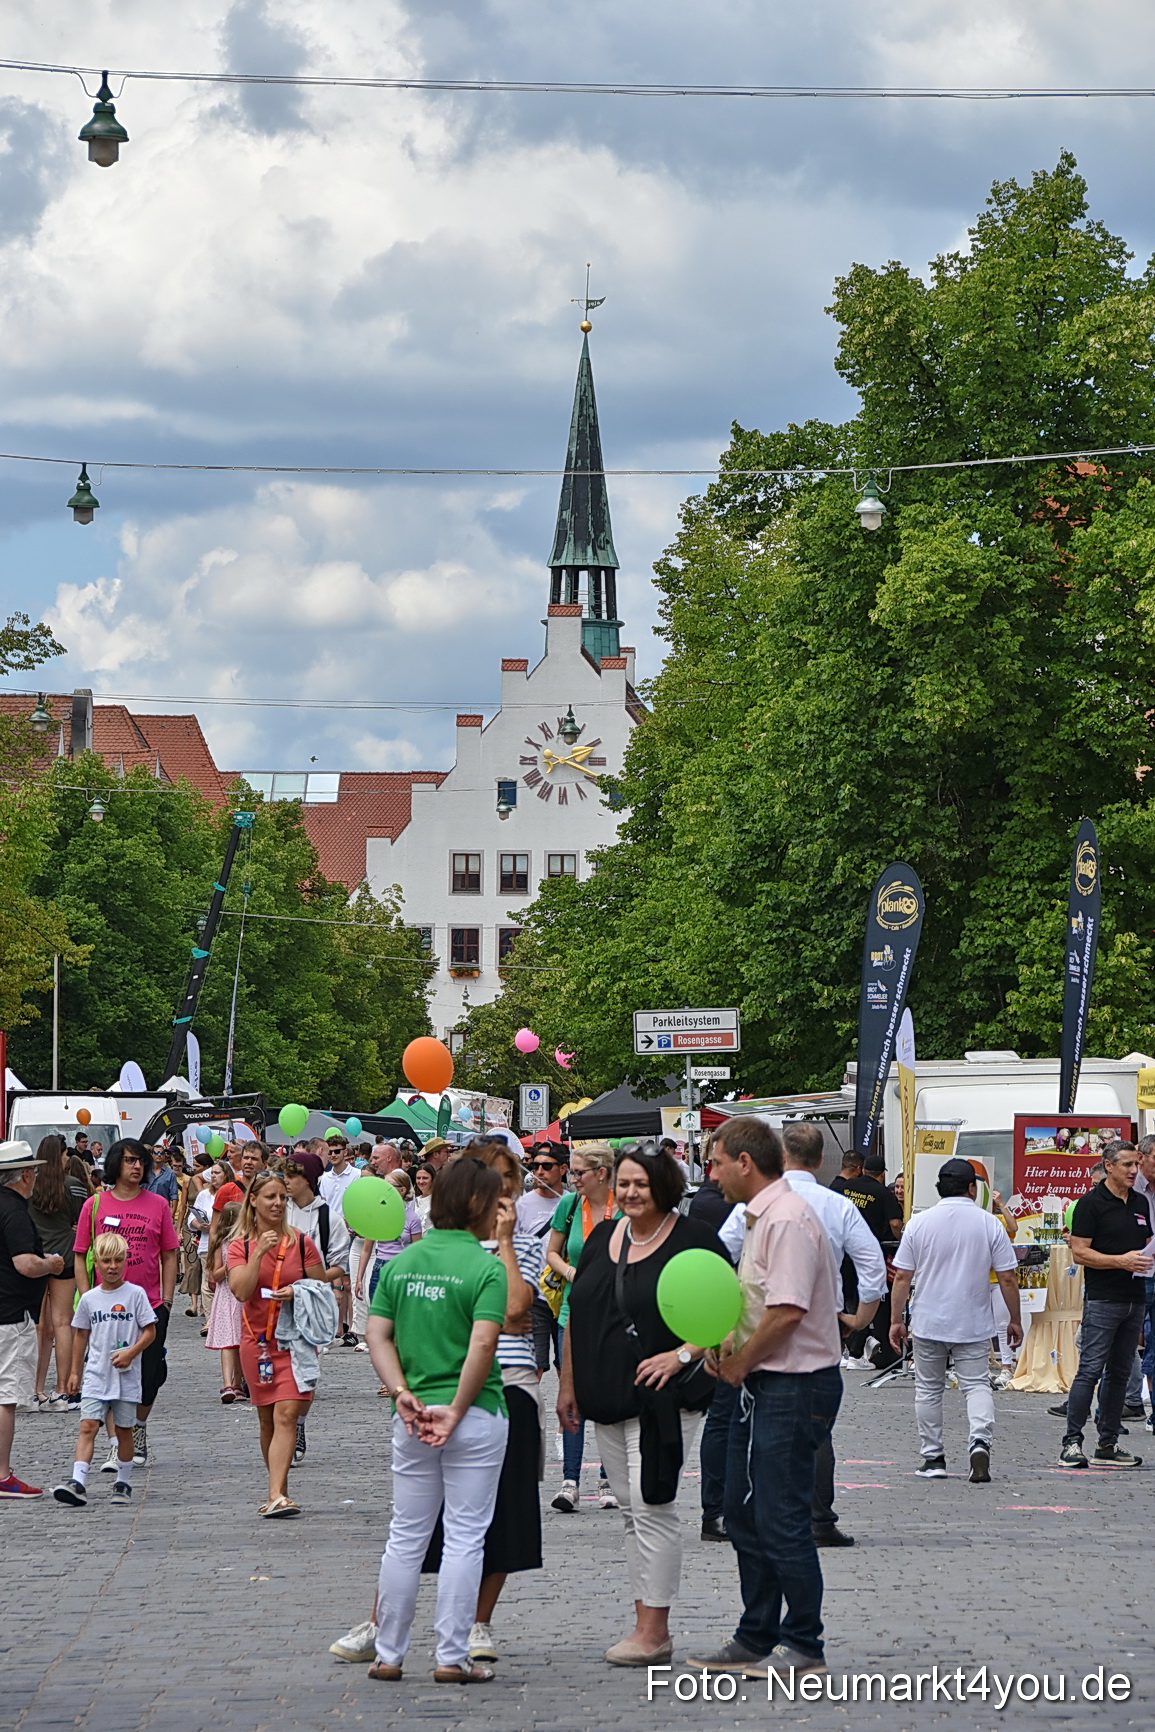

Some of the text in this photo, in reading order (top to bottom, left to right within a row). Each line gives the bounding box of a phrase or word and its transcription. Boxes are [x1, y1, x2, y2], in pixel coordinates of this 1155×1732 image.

[1083, 916, 1094, 975] schmeckt
[652, 1015, 720, 1028] Parkleitsystem
[869, 1080, 882, 1121] Heimat
[878, 1038, 892, 1080] einfach
[885, 1000, 900, 1038] besser
[895, 947, 912, 1001] schmeckt
[678, 1035, 722, 1046] Rosengasse
[694, 1069, 726, 1078] Rosengasse
[1024, 1166, 1049, 1177] Hier
[1050, 1166, 1067, 1178] bin
[1068, 1166, 1082, 1178] ich
[1046, 1182, 1071, 1194] kann
[1073, 1183, 1087, 1194] ich
[126, 1213, 151, 1224] PRODUCT
[127, 1257, 145, 1267] MADE
[406, 1281, 446, 1302] Pflege
